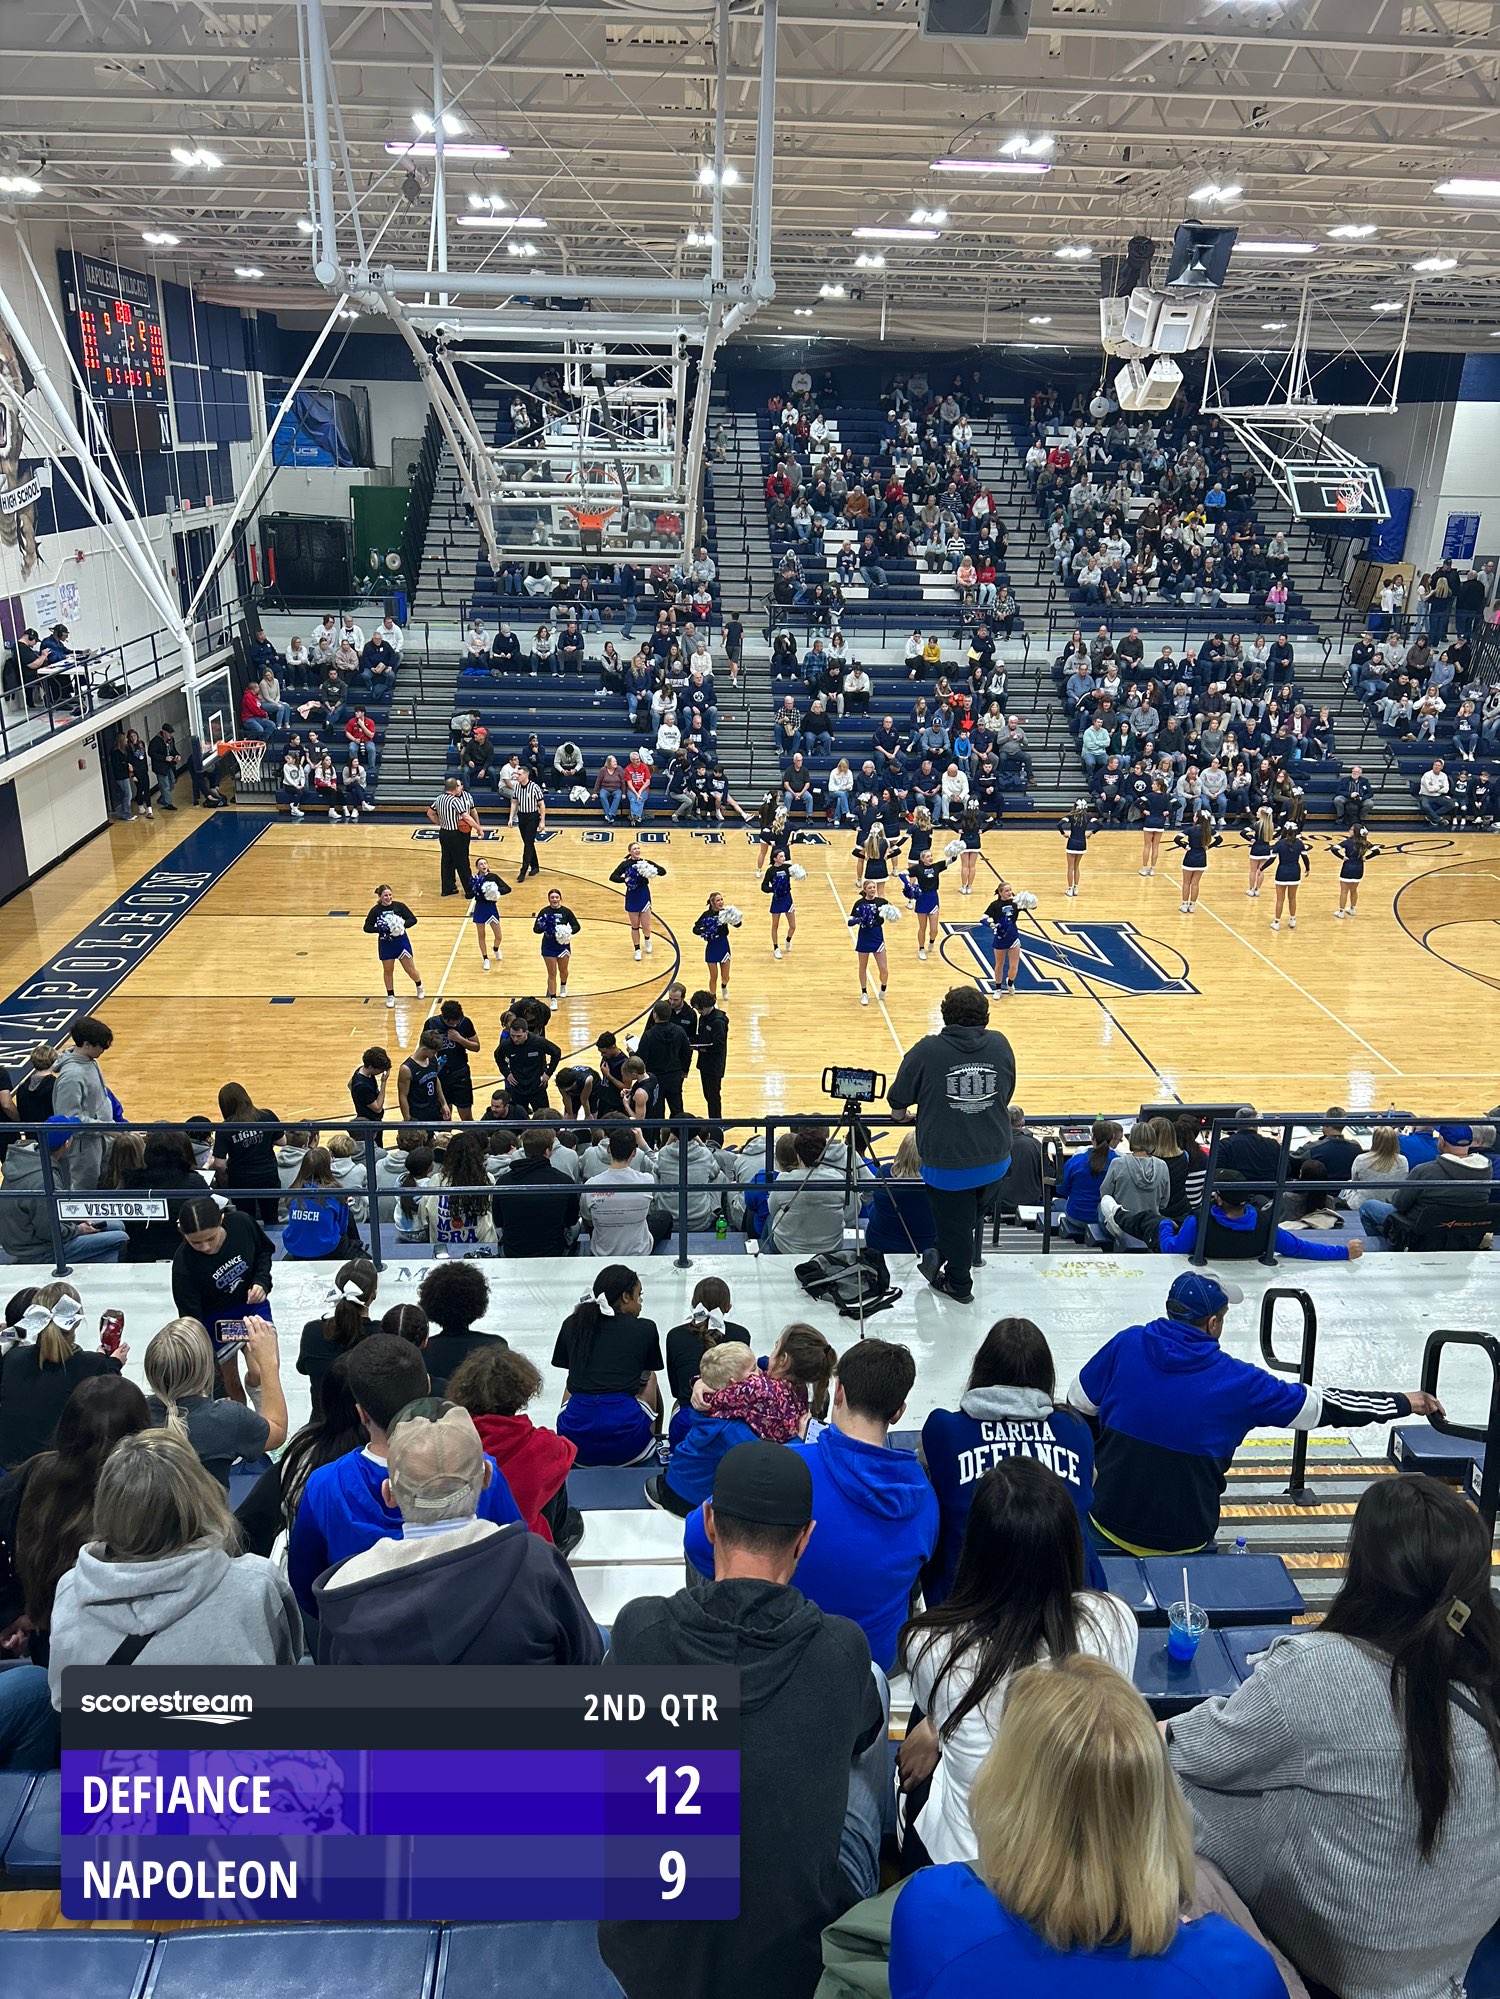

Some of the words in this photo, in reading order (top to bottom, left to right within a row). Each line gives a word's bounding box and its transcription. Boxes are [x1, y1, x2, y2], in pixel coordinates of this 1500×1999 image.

[85, 264, 118, 291] NAPOLEON
[119, 274, 148, 298] WILDCATS
[1, 493, 17, 510] HIGH
[17, 481, 40, 505] SCHOOL
[940, 921, 1202, 994] N
[426, 1081, 435, 1096] 3
[84, 1203, 144, 1216] VISITOR
[437, 1229, 479, 1243] ERA
[212, 1254, 243, 1280] DEFIANCE
[215, 1260, 249, 1289] CHEER
[981, 1421, 1056, 1441] GARCIA
